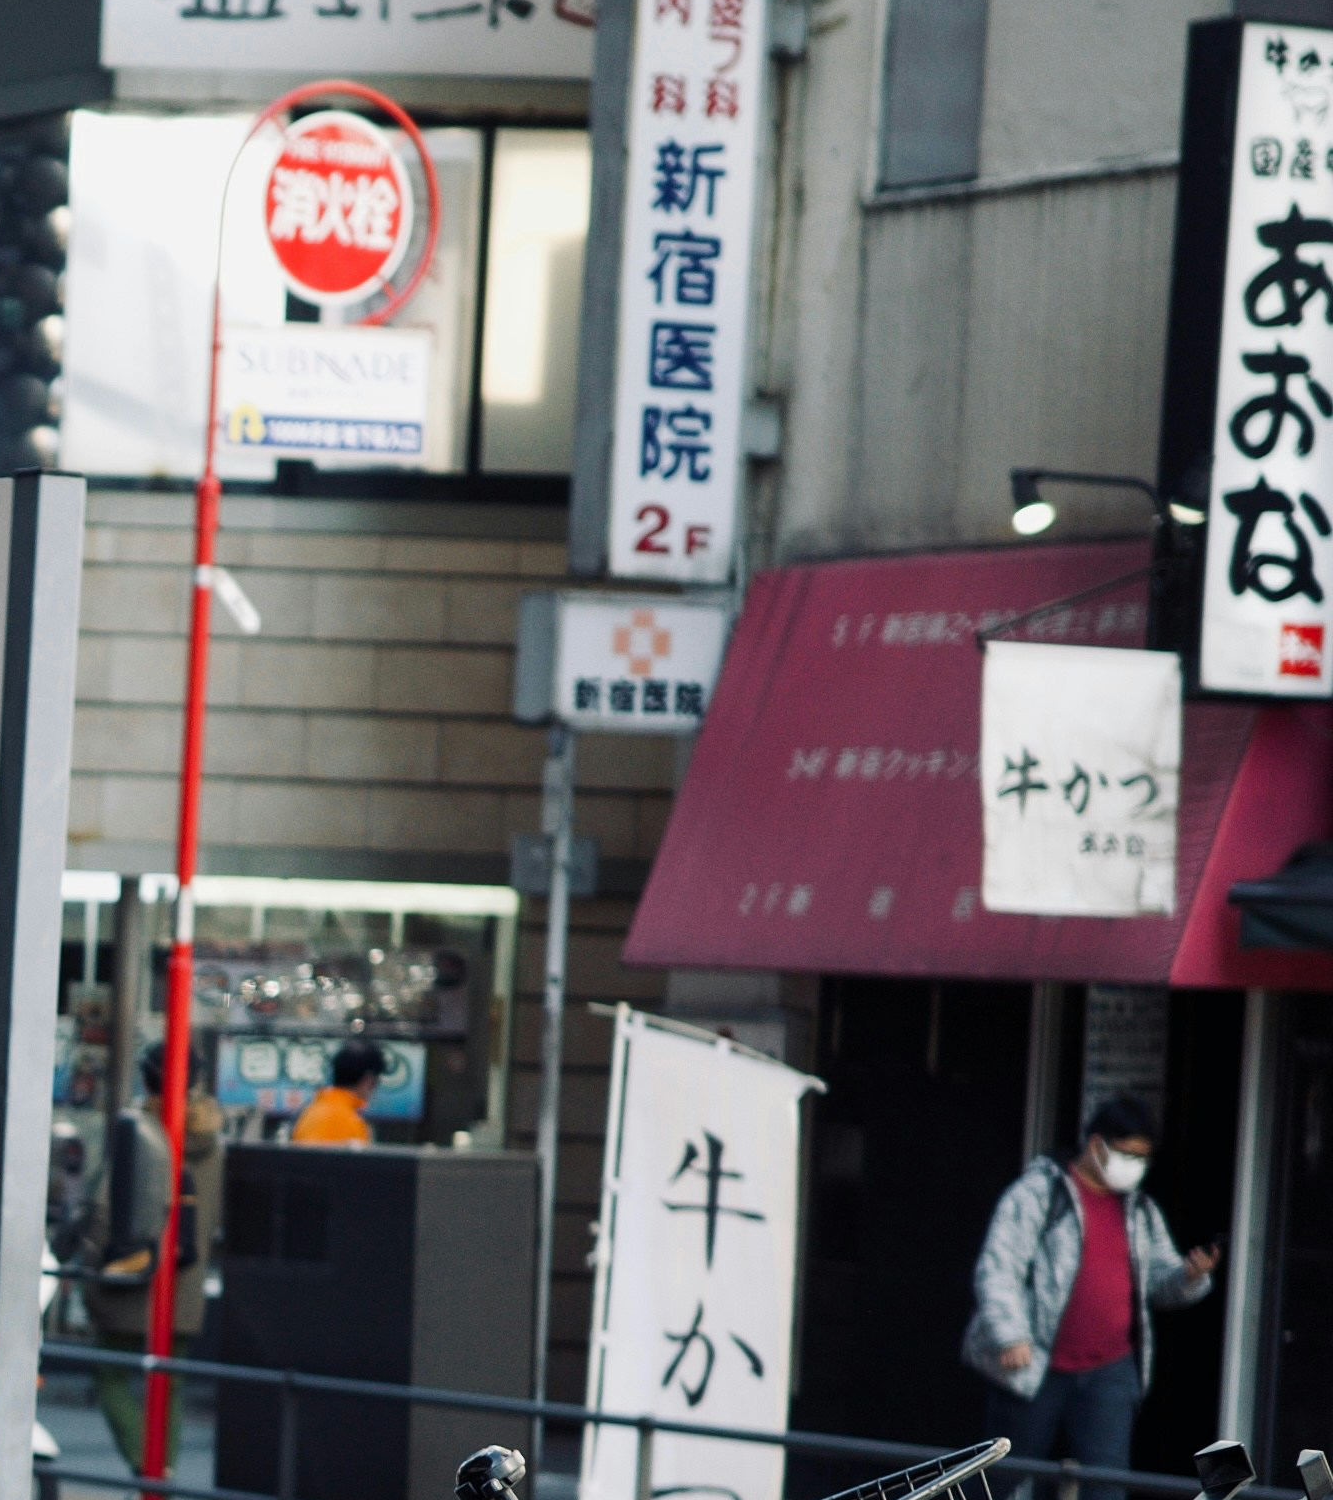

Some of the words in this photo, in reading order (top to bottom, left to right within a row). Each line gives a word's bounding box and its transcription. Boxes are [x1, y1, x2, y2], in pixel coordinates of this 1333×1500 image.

[268, 163, 400, 251] 消火栓
[638, 139, 727, 485] 新宿医院
[1223, 202, 1333, 603] あおな
[633, 505, 713, 559] 2F
[572, 677, 706, 719] 新宿医院
[835, 746, 982, 782] 新宿クッキン
[997, 746, 1161, 816] 牛かつ
